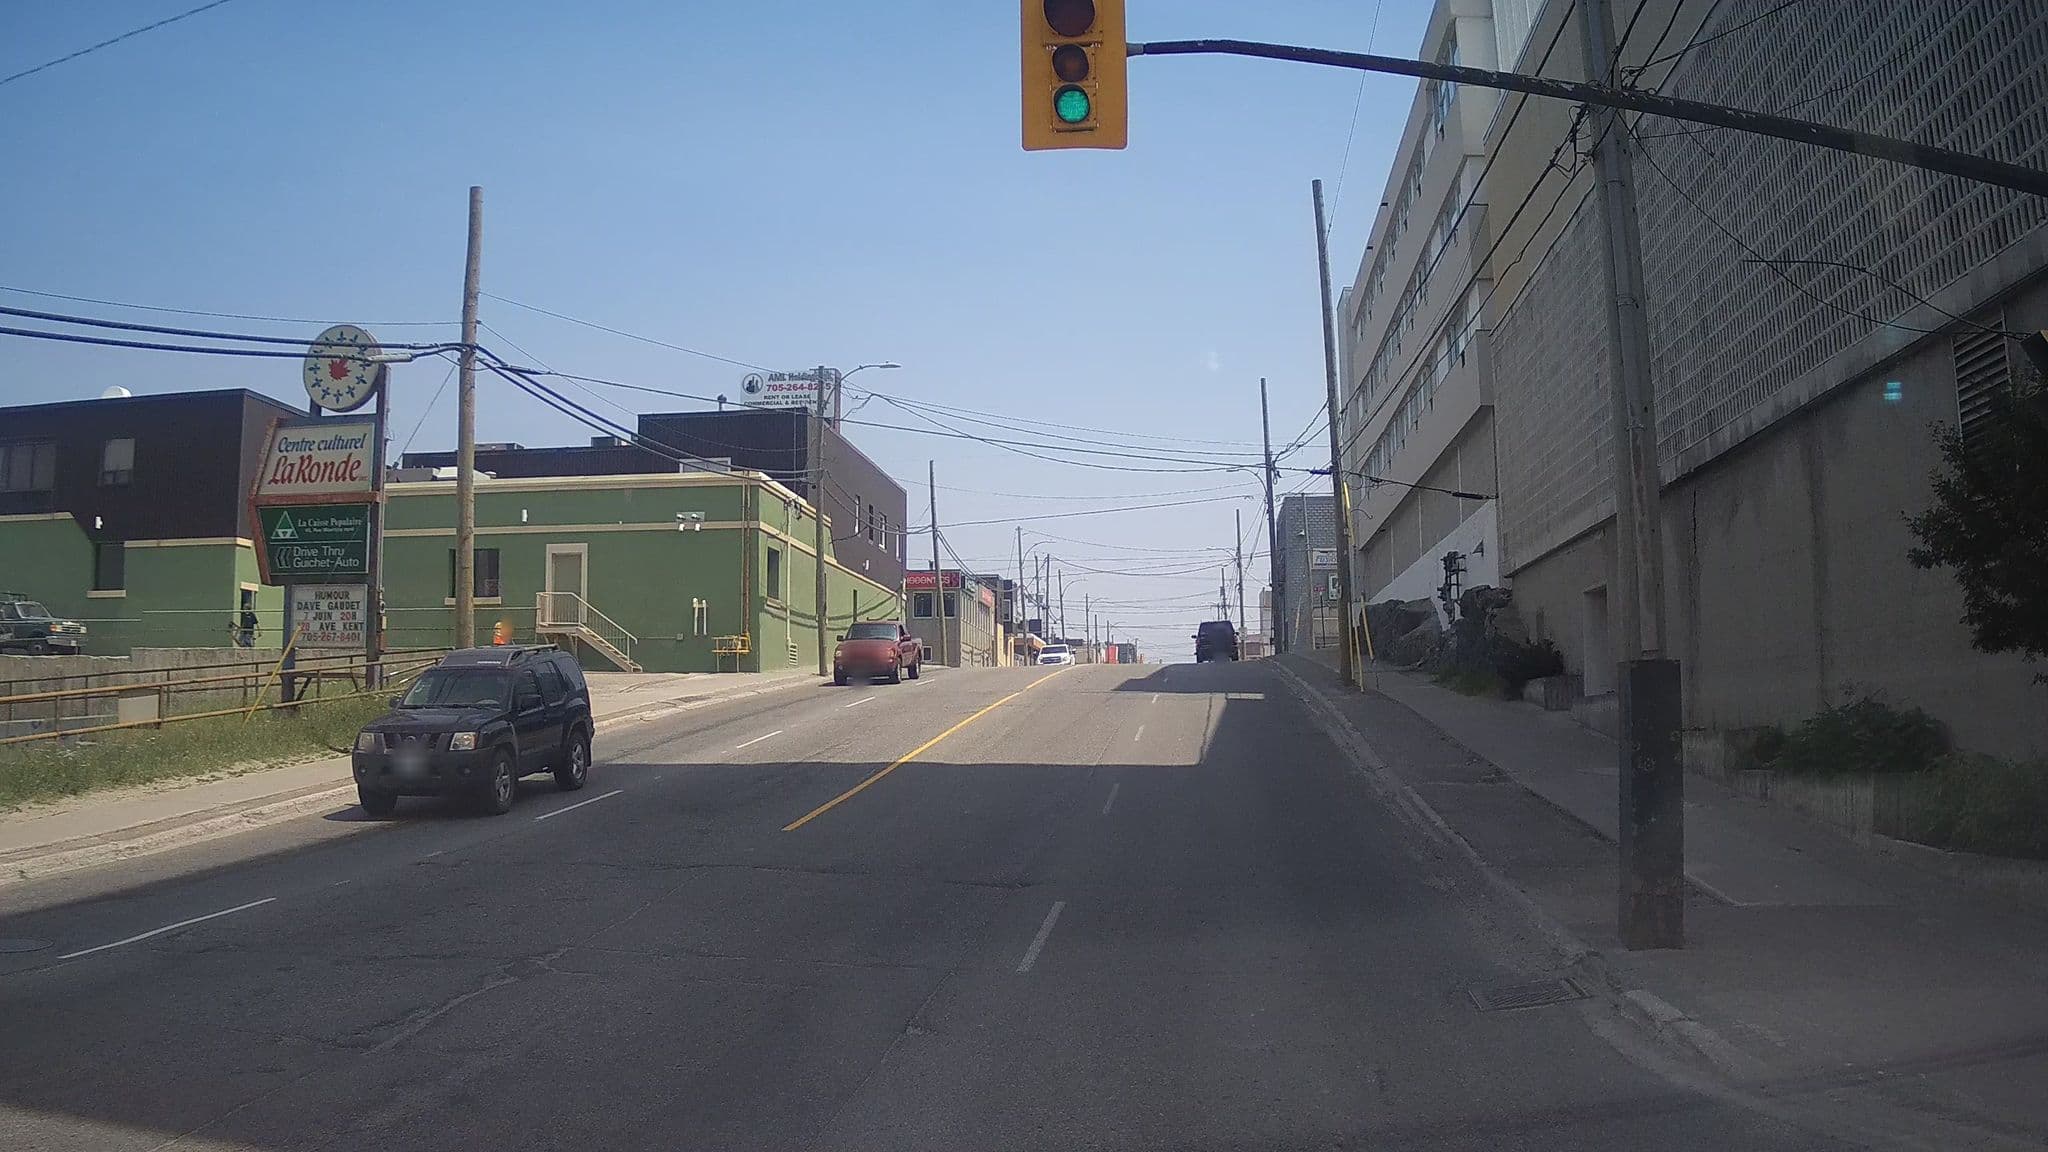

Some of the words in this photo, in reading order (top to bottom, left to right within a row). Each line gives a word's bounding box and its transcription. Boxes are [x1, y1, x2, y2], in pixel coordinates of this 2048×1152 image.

[767, 382, 832, 391] 705-264-825
[278, 437, 315, 452] Centre
[318, 433, 367, 451] culturel
[294, 546, 318, 556] Drive
[322, 546, 345, 556] Thru
[293, 557, 360, 568] Guichet-Auto
[315, 591, 350, 600] HUMOUR
[296, 602, 321, 610] DAVE
[327, 601, 360, 610] GAUDET
[304, 611, 309, 620] 7
[312, 612, 333, 620] JUIN
[319, 622, 336, 631] AVE
[342, 622, 365, 631] KENT
